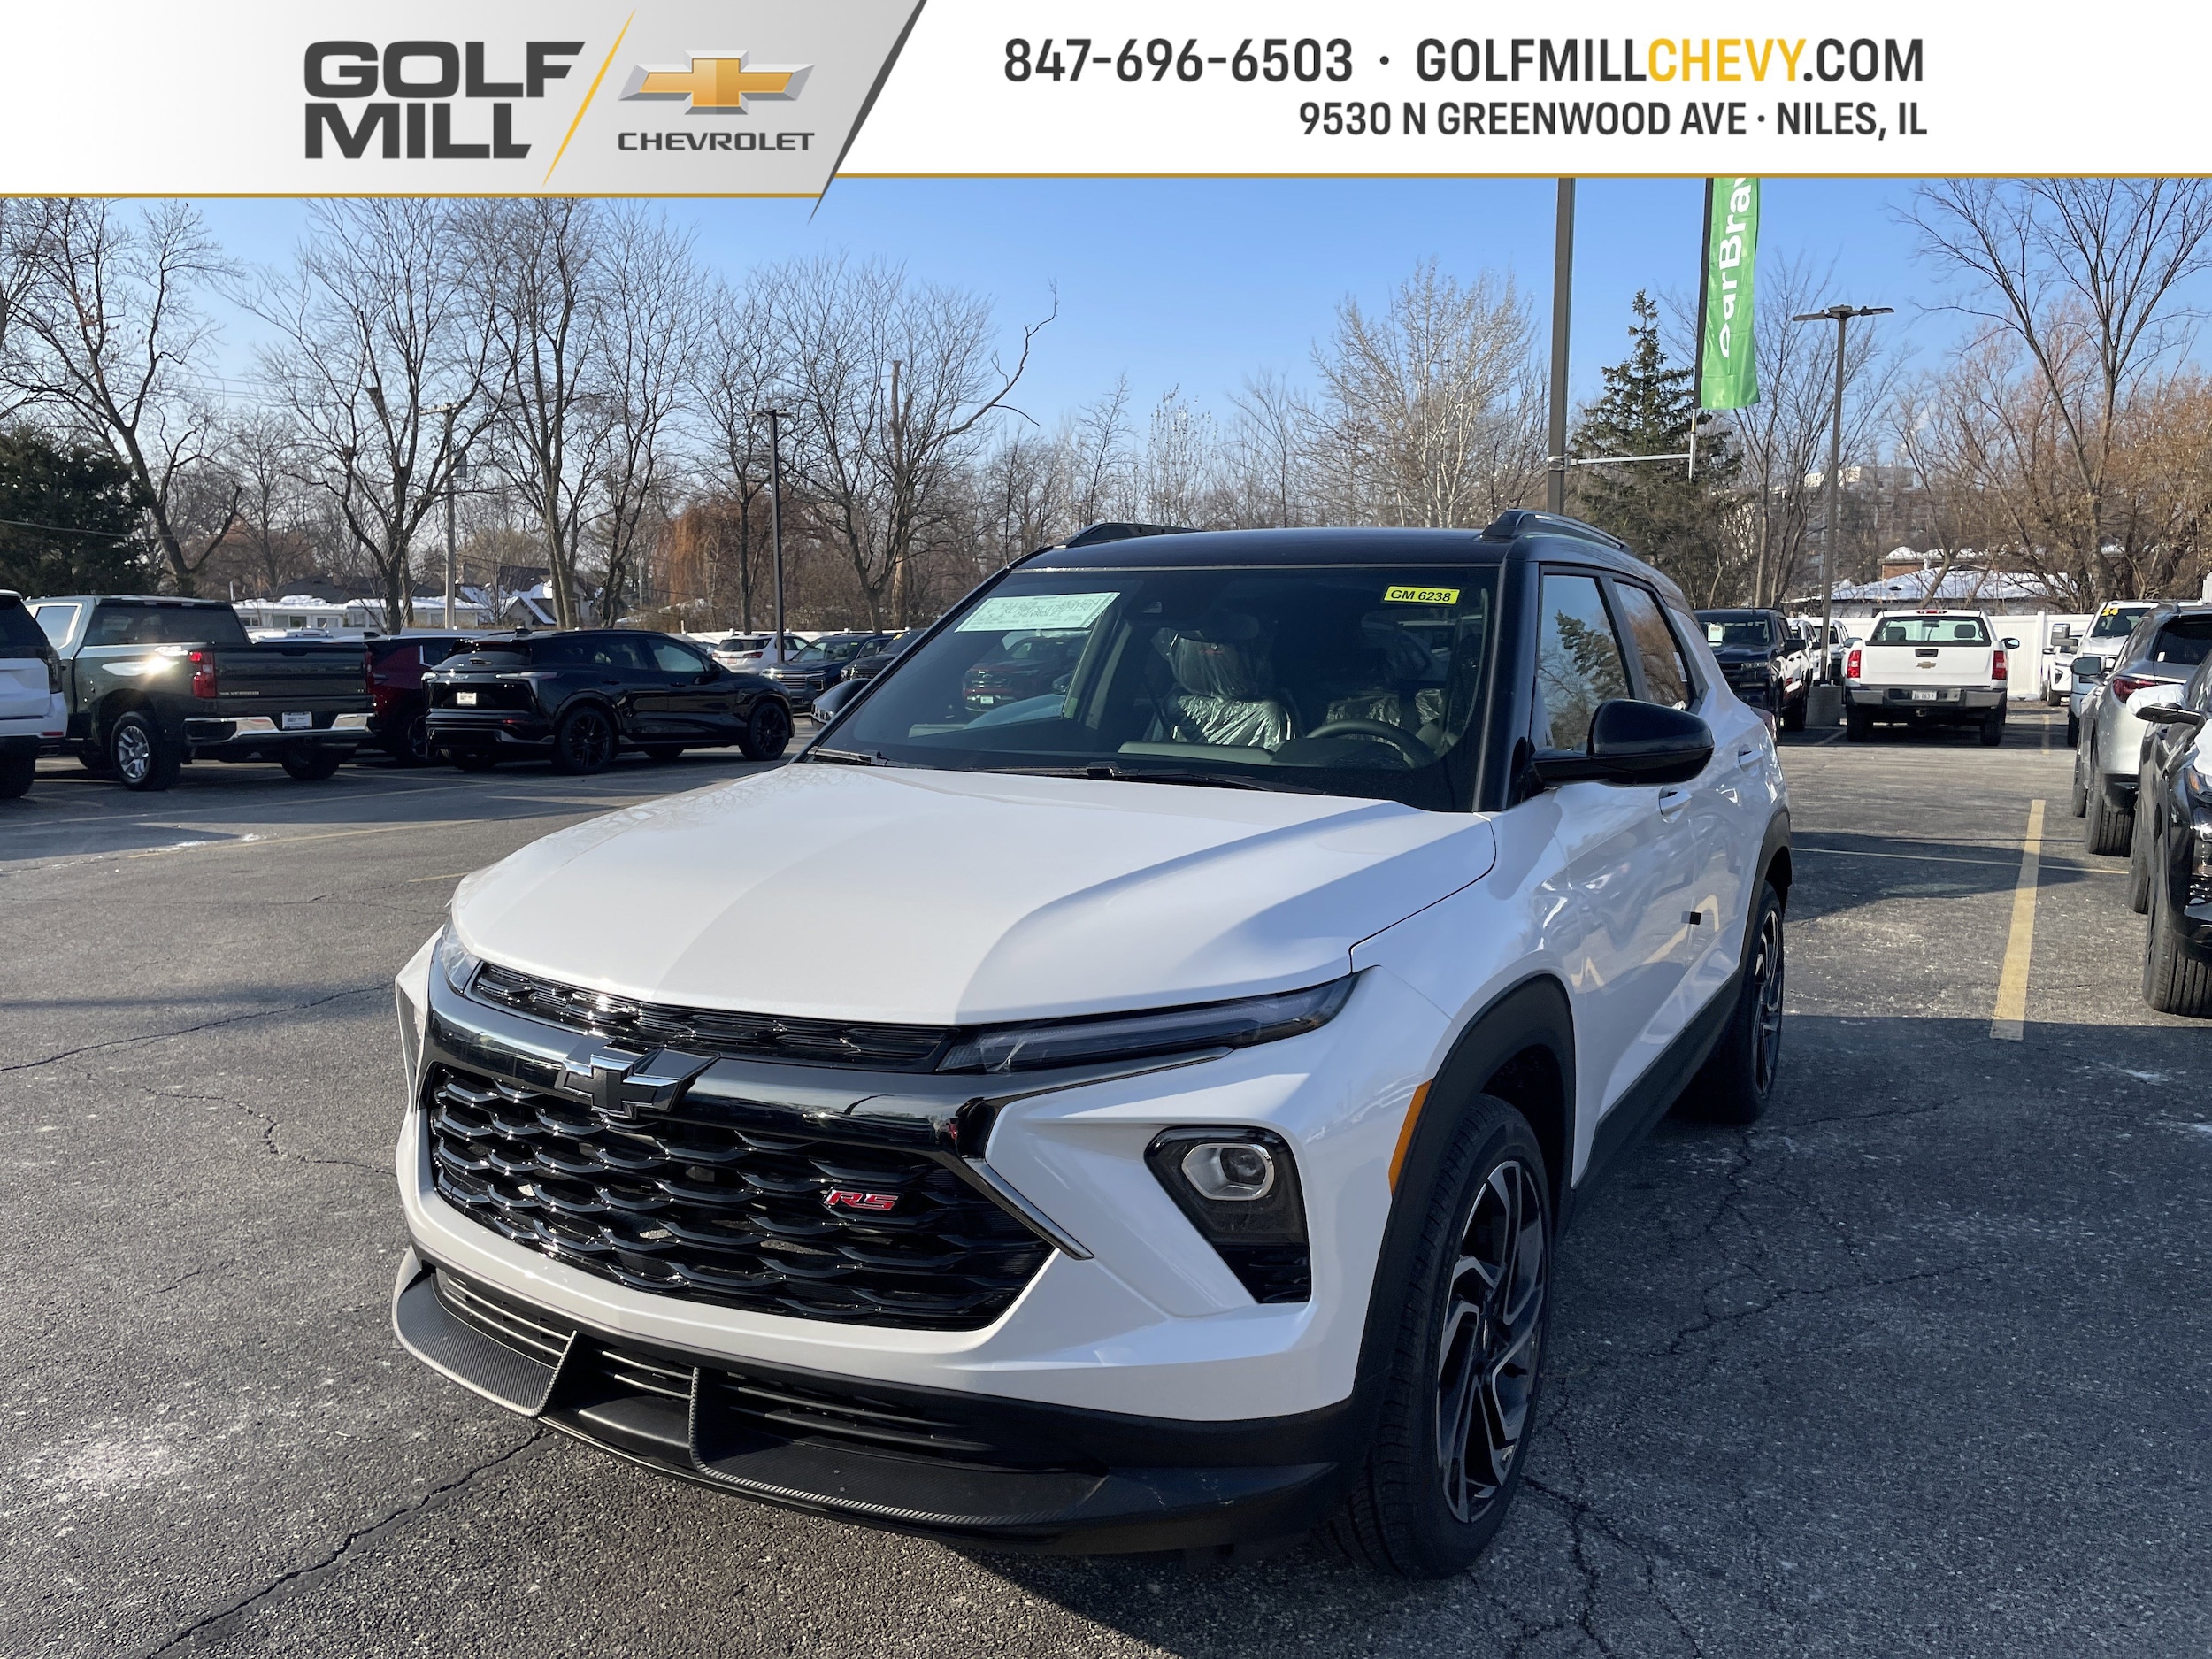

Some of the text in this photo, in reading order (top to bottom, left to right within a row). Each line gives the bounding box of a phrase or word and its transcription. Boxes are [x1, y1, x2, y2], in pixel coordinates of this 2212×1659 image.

[1391, 590, 1451, 602] GM 6238
[824, 1189, 899, 1210] RS
